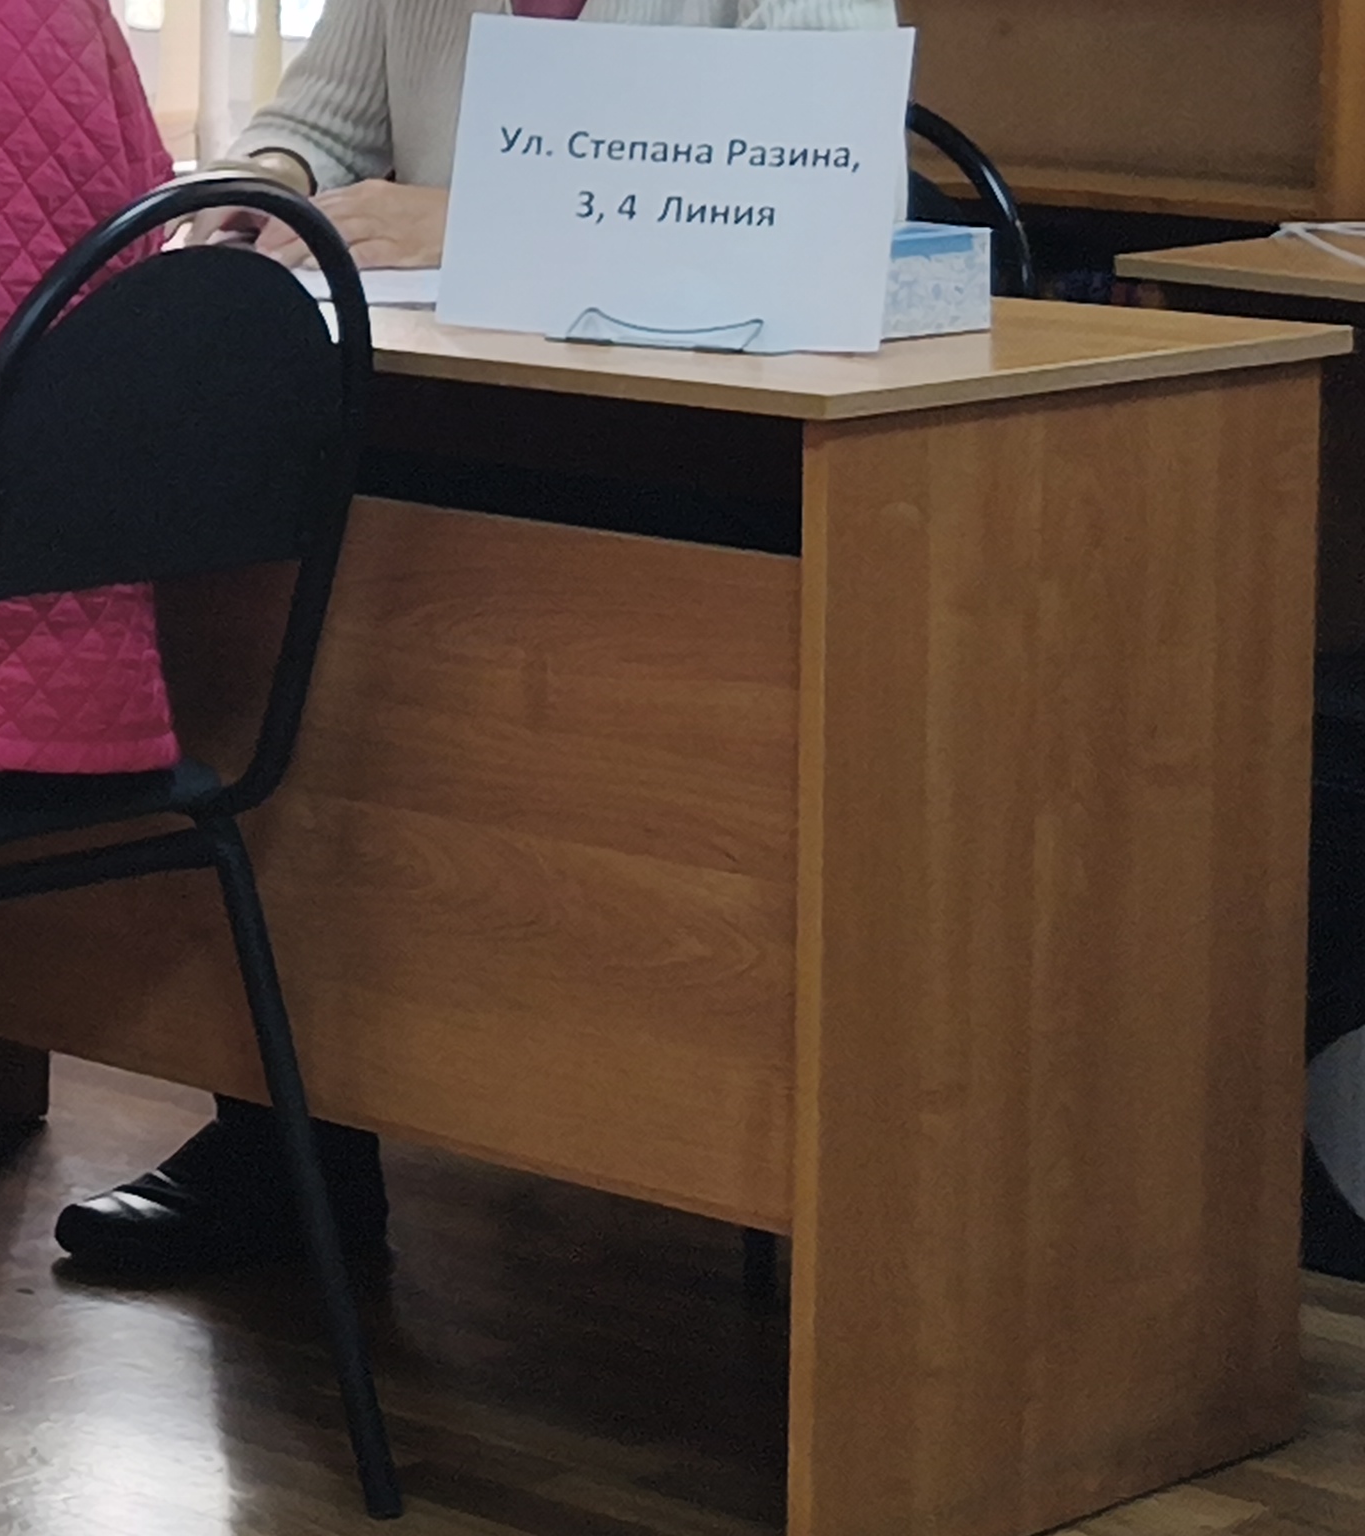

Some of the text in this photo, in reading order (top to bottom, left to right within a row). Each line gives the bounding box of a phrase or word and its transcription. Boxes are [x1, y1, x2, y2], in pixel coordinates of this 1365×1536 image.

[499, 125, 861, 173] Ул. Степана Разина,
[575, 190, 776, 227] 3, 4 Линия
